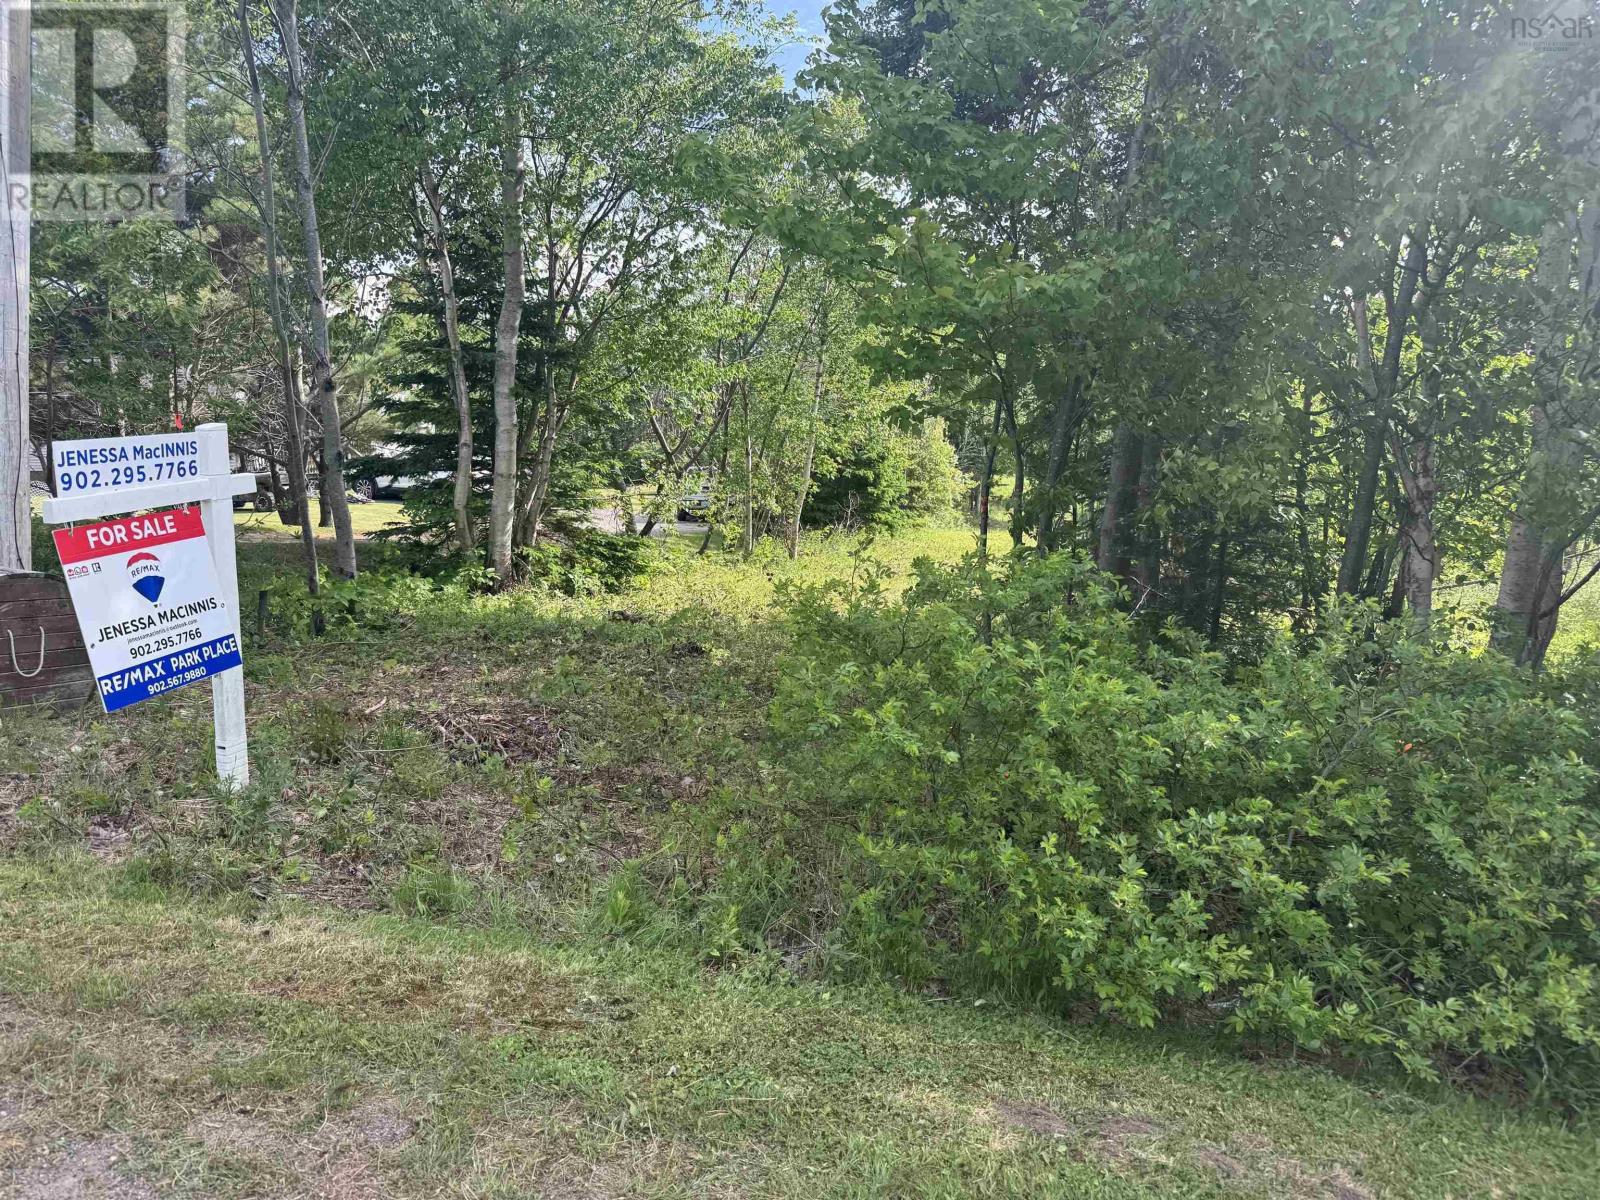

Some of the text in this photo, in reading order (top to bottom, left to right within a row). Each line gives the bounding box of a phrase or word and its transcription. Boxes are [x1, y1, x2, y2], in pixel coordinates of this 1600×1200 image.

[57, 441, 198, 467] JENESSA MacINNIS
[60, 460, 198, 491] 902.295.7766
[86, 515, 177, 549] FOR SALE
[131, 564, 160, 578] RE/MAX
[98, 597, 217, 642] JENESSA MACINNIS
[129, 628, 203, 659] 902.295.7766
[100, 637, 237, 696] RE/MAX PARK PLACE
[147, 667, 207, 695] 902.567.9880
